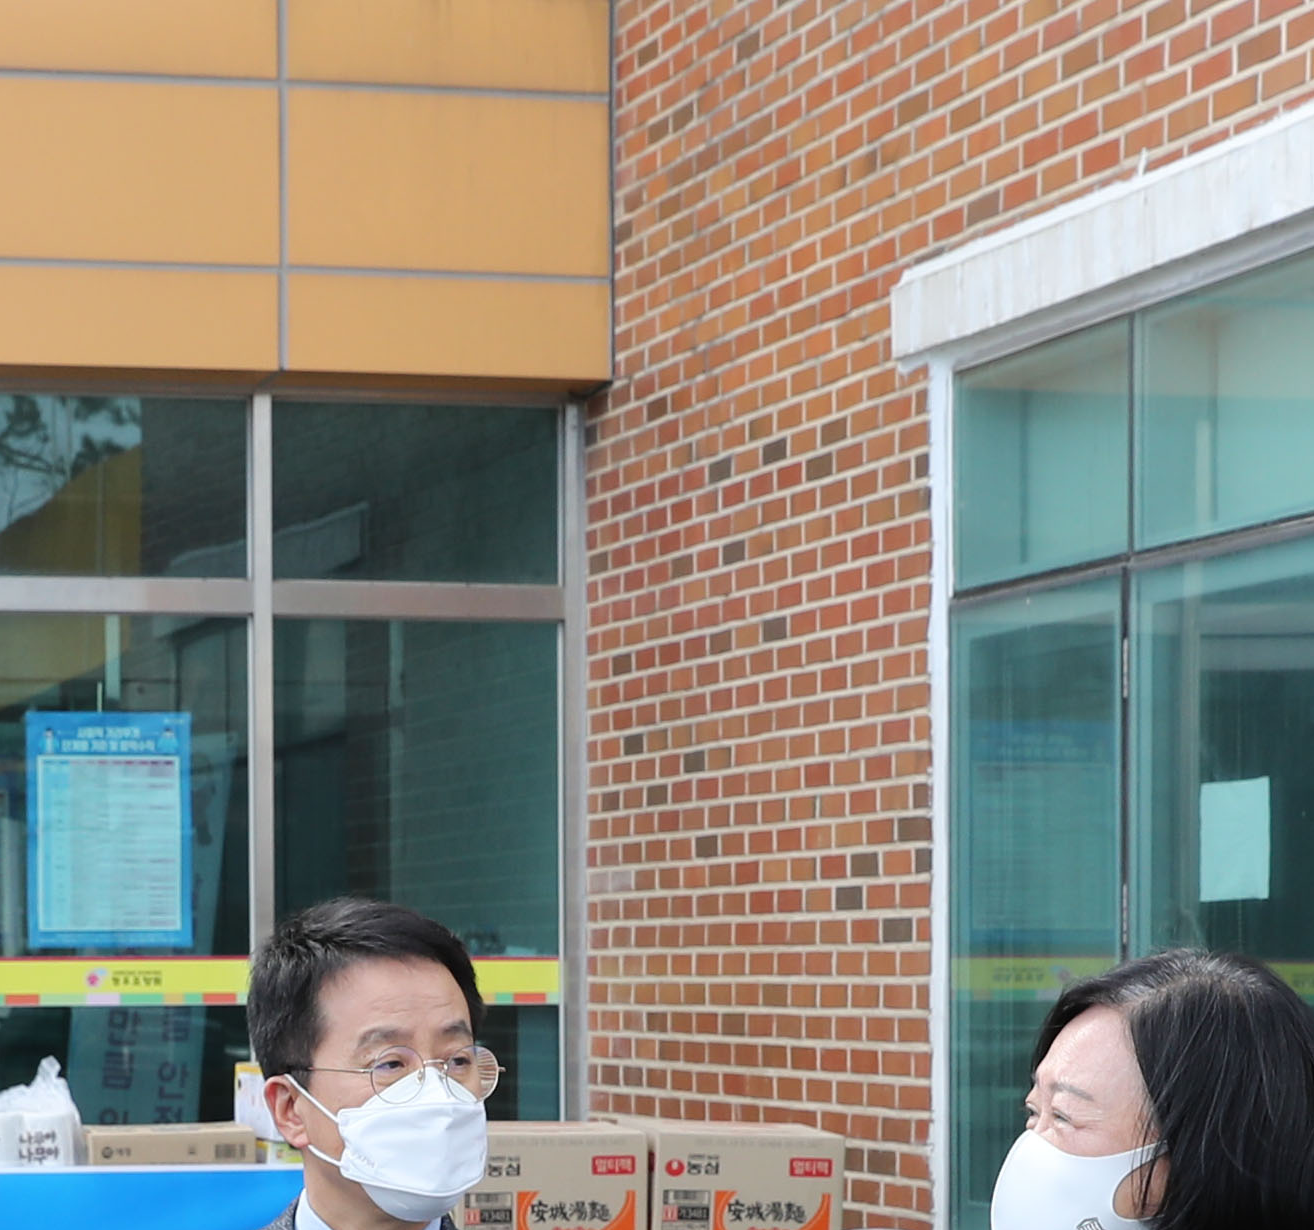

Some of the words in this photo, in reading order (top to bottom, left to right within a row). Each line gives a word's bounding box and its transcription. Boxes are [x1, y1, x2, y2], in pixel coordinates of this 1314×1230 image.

[487, 1163, 522, 1178] 농심
[594, 1156, 634, 1174] 멀티팩
[686, 1160, 720, 1176] 농심
[792, 1159, 831, 1176] 멀티팩
